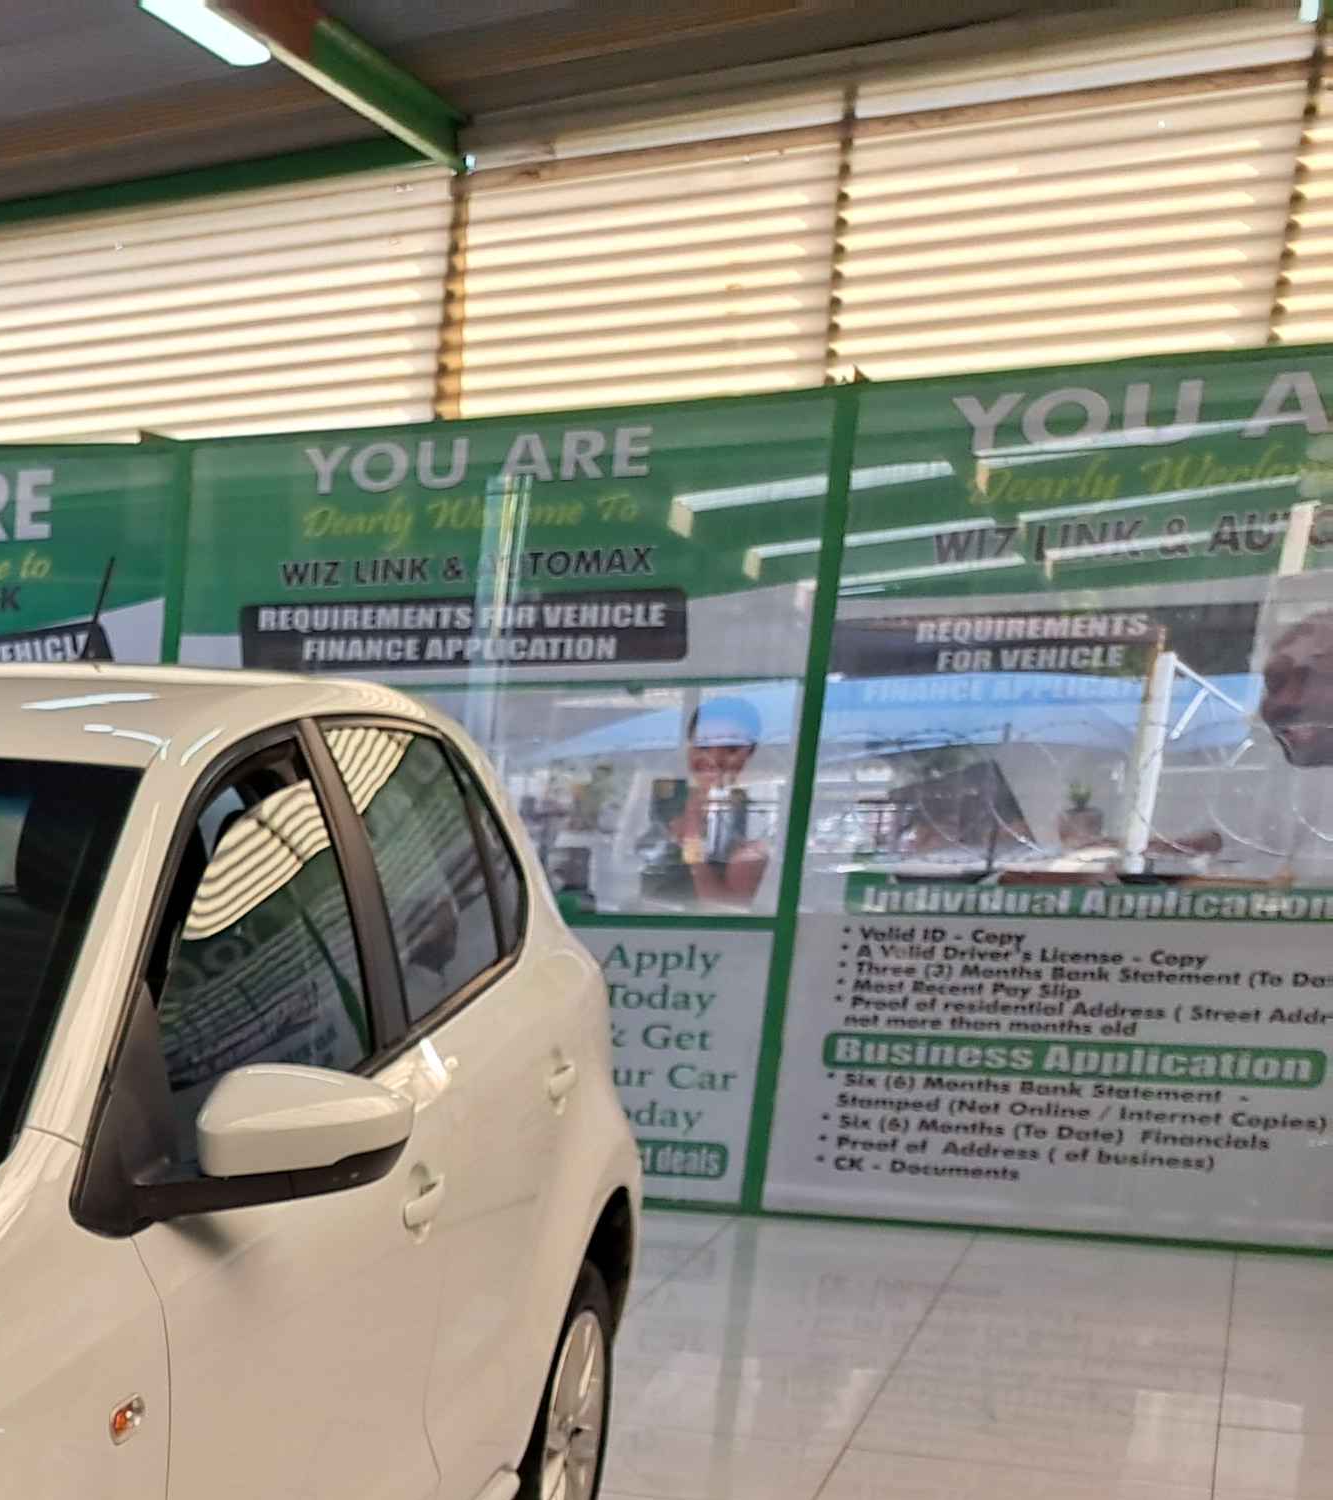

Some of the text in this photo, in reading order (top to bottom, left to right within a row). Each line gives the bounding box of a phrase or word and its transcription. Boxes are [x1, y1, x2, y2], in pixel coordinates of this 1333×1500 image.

[952, 378, 1205, 453] YOU
[305, 426, 653, 494] YOU ARE
[935, 527, 1019, 563] WIZ
[1037, 520, 1142, 562] LINK
[1161, 516, 1190, 558] &
[19, 551, 53, 578] to
[282, 560, 340, 586] WIZ
[355, 556, 430, 584] LINK
[442, 555, 464, 580] &
[258, 602, 666, 632] REQUIREMENTS FOR VEHICLE
[915, 613, 1148, 644] REQUIREMENTS
[304, 635, 616, 662] FINANCE APPLICATION
[936, 645, 1125, 673] FOR VEHICLE
[862, 886, 1071, 914] Individual
[860, 927, 916, 943] Valid
[923, 928, 946, 943] ID
[971, 928, 1026, 949] Copy
[605, 945, 721, 978] Apply
[857, 945, 872, 960] A
[881, 945, 933, 960] Valid
[1040, 948, 1124, 965] License
[1150, 950, 1208, 970] Copy
[852, 979, 1081, 1000] Most Recent Pay Slip
[857, 961, 917, 977] Three
[961, 963, 1042, 981] Months
[1051, 966, 1109, 984] Bank
[1119, 968, 1241, 986] Statement
[1249, 970, 1282, 989] (To
[608, 984, 717, 1016] Today
[850, 995, 909, 1011] Proof
[916, 998, 938, 1012] of
[944, 998, 1064, 1016] residential
[1072, 1002, 1166, 1020] Address
[1191, 1005, 1261, 1023] Street
[642, 1024, 714, 1052] Get
[845, 1015, 1138, 1037] not more than months old
[835, 1038, 1313, 1082] Business Application
[668, 1065, 738, 1091] Car
[844, 1073, 876, 1088] Six
[923, 1077, 1011, 1095] Months
[1019, 1080, 1082, 1097] Bank
[1092, 1083, 1222, 1103] Statement
[837, 1093, 940, 1112] Stamped
[949, 1098, 1000, 1116] (Not
[1008, 1101, 1091, 1118] Online
[1120, 1106, 1222, 1125] Internet
[1231, 1111, 1328, 1134] Copies)
[840, 1114, 871, 1129] Six
[918, 1118, 1005, 1137] Months
[1013, 1122, 1047, 1141] (To
[1058, 1126, 1124, 1146] Date)
[1141, 1129, 1271, 1151] Financials
[837, 1135, 898, 1151] Proof
[906, 1139, 928, 1154] of
[942, 1141, 1040, 1160] Address
[1064, 1149, 1089, 1164] of
[1097, 1150, 1215, 1173] business)
[835, 1157, 863, 1171] CK
[890, 1159, 1021, 1181] Documents
